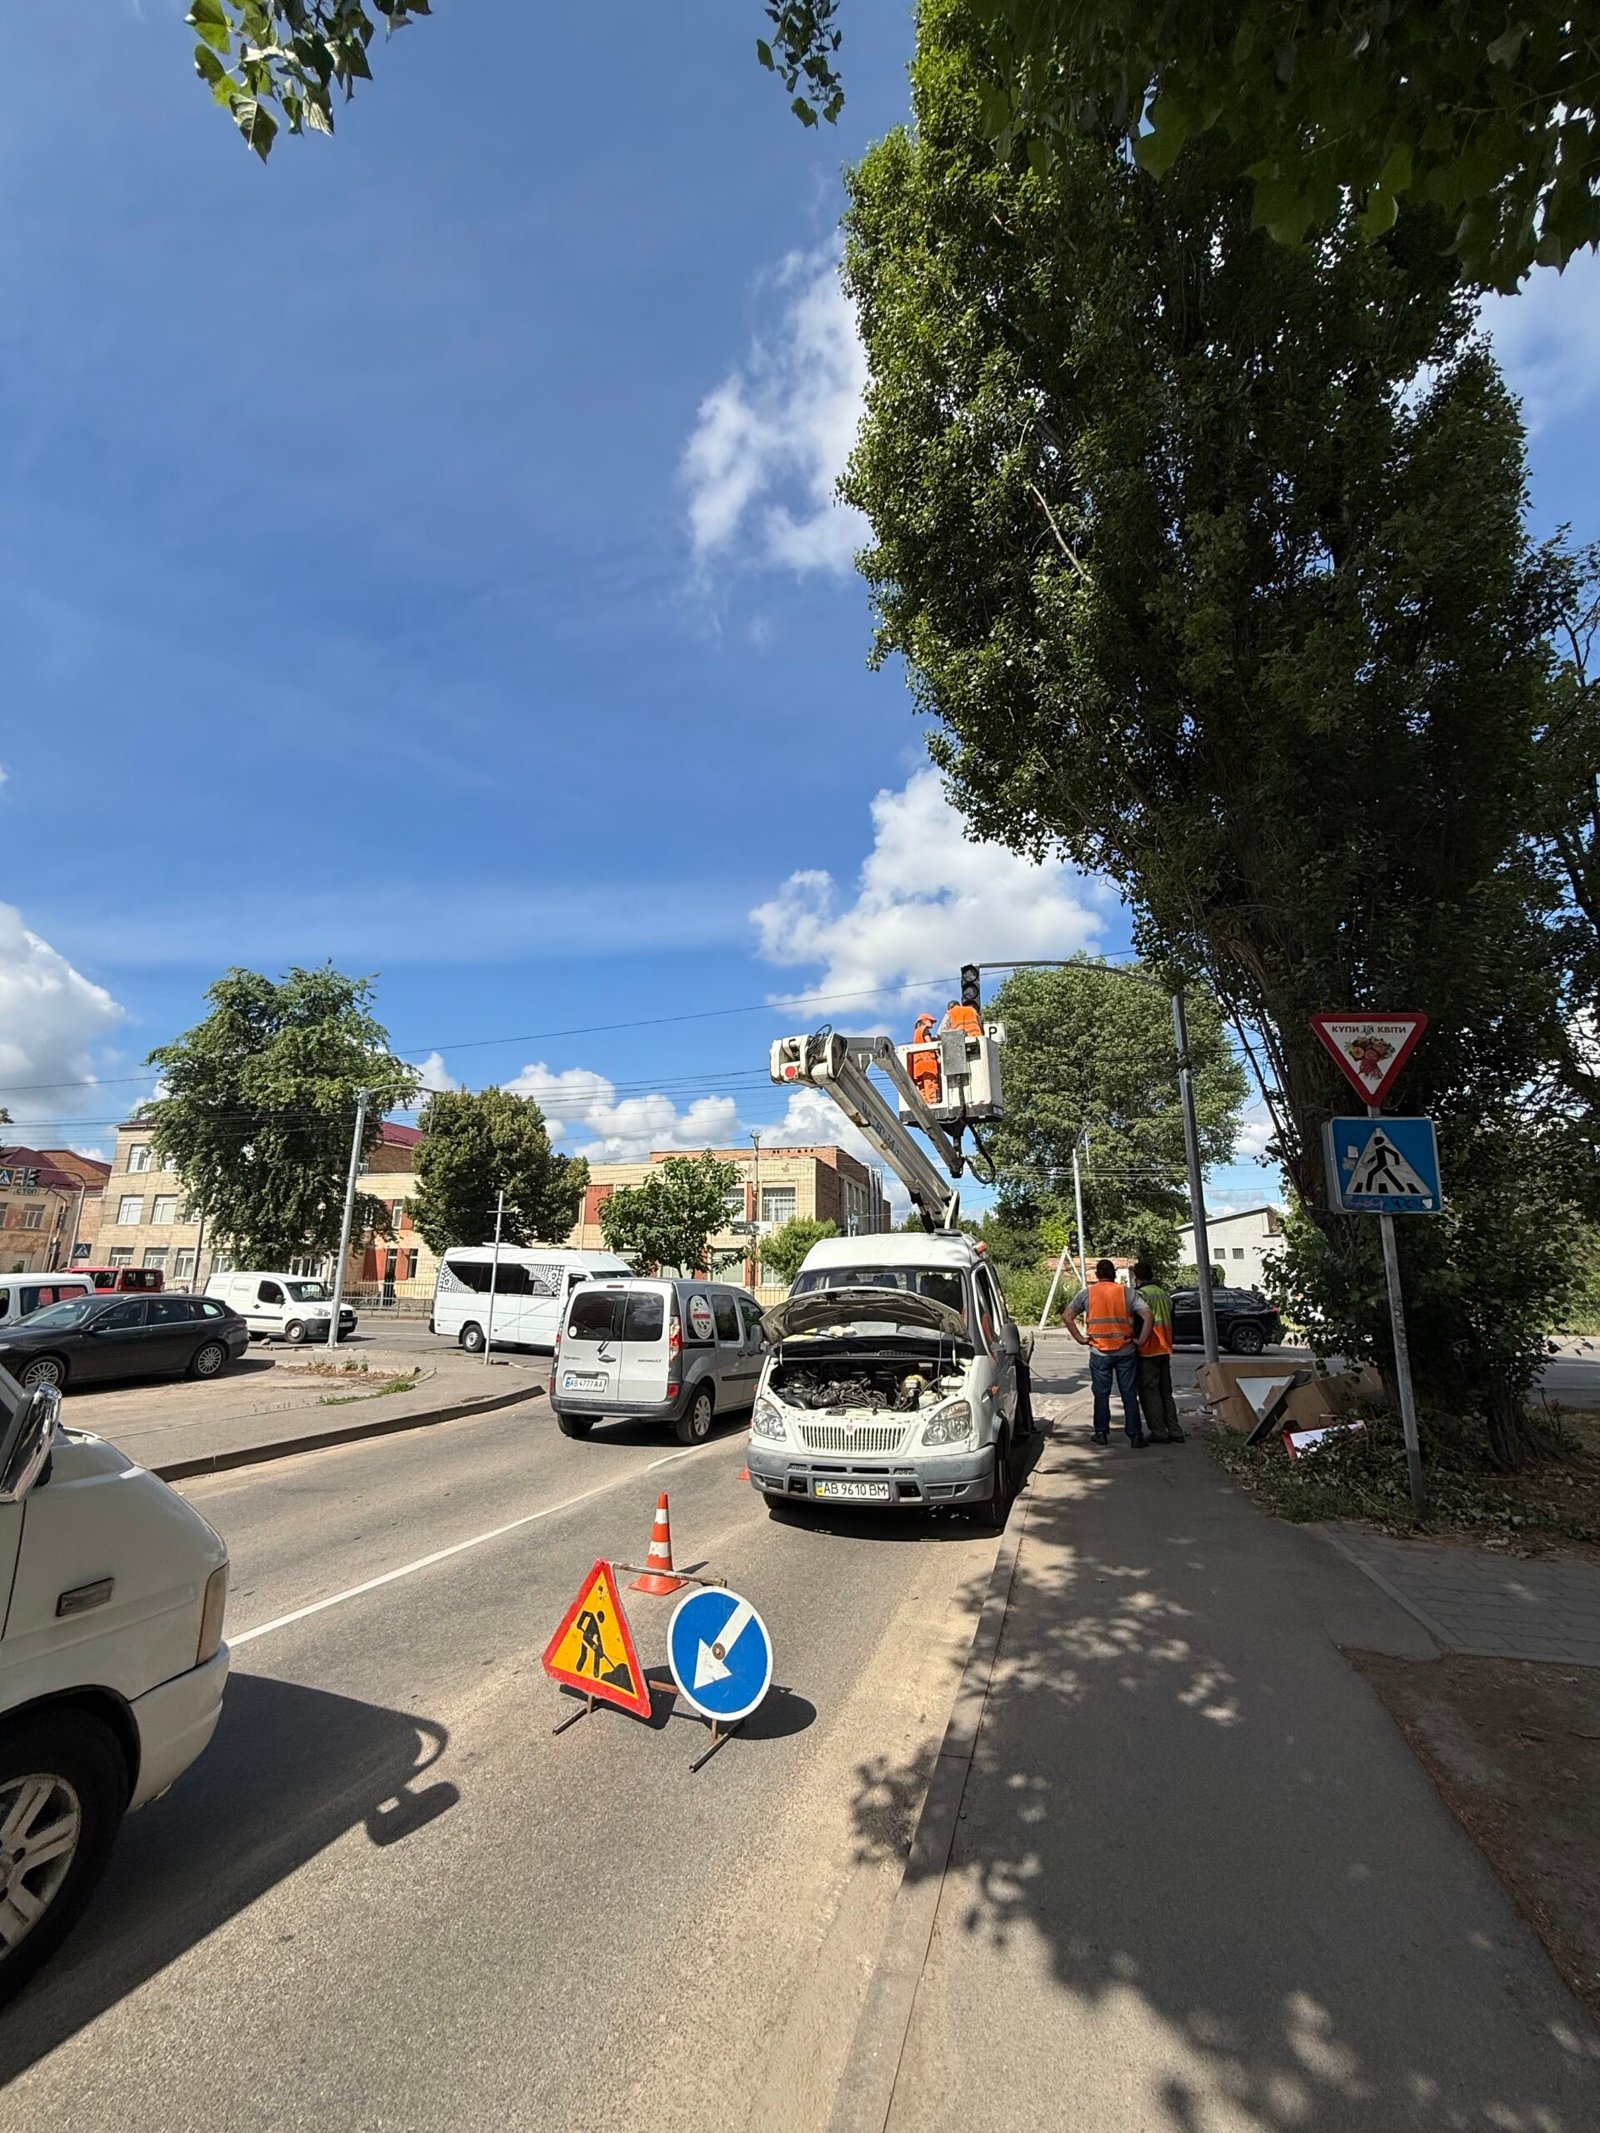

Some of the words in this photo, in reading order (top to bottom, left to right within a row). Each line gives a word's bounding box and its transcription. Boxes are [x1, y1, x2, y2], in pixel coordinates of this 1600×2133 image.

[1331, 1025, 1360, 1033] КУПИ
[1377, 1026, 1407, 1034] КВІТИ
[824, 1483, 839, 1495] AB
[841, 1484, 867, 1496] 9610
[869, 1484, 886, 1496] BM
